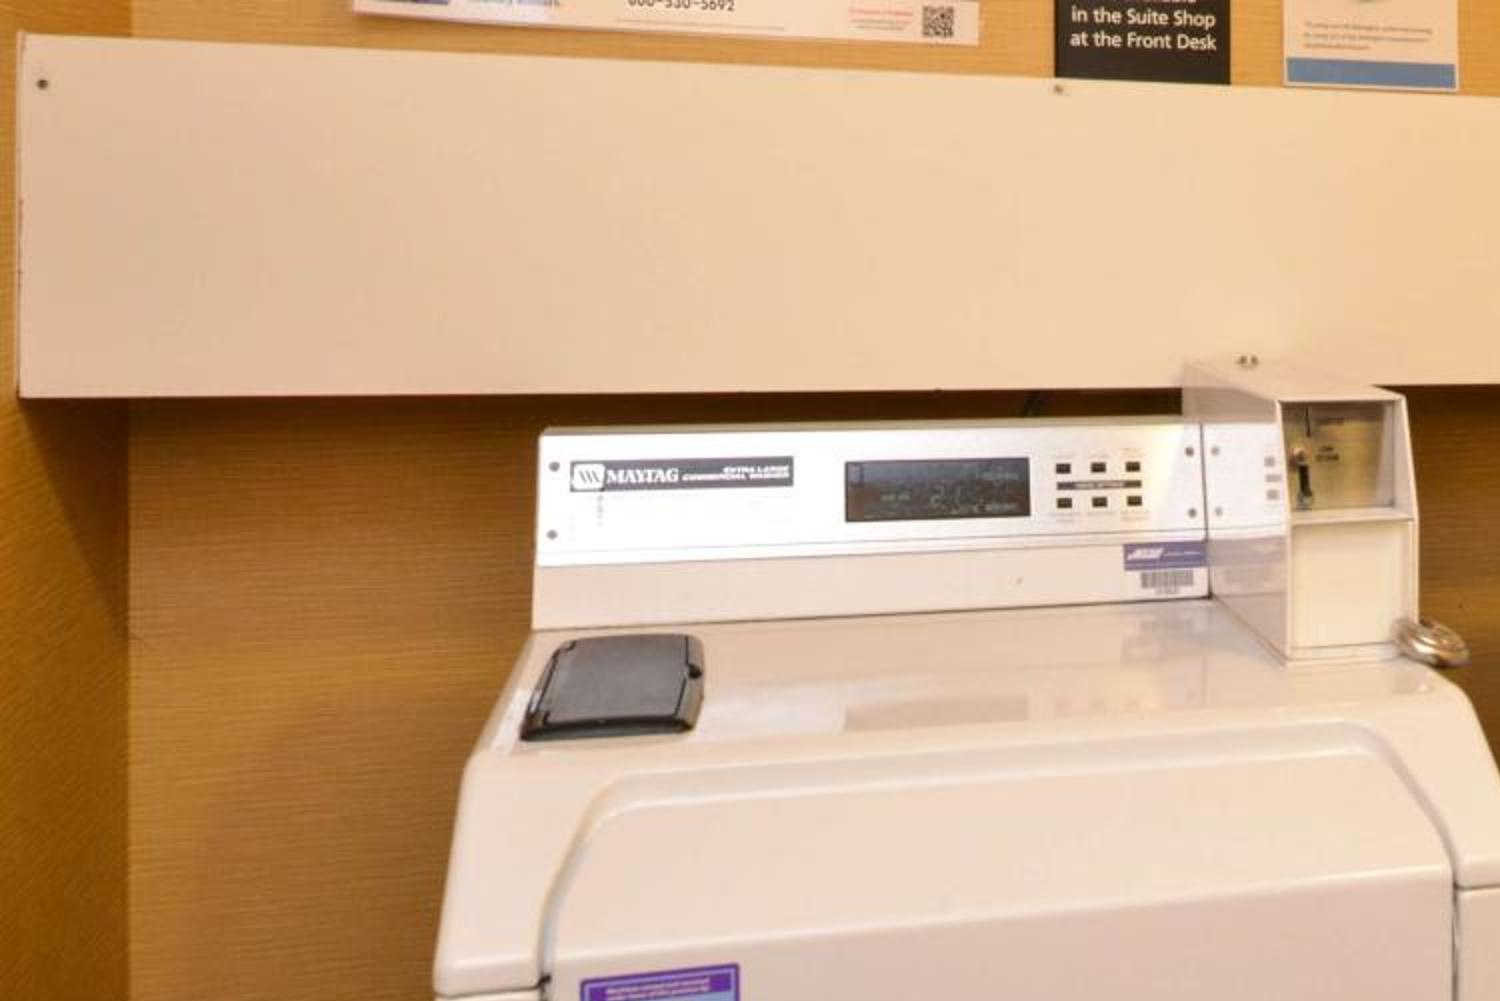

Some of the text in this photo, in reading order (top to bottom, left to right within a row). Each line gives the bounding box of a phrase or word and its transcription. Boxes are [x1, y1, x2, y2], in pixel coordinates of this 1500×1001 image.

[1071, 6, 1215, 29] in the Suite Shop
[1069, 31, 1216, 50] at the Front Desk
[606, 468, 678, 484] MAYTAG
